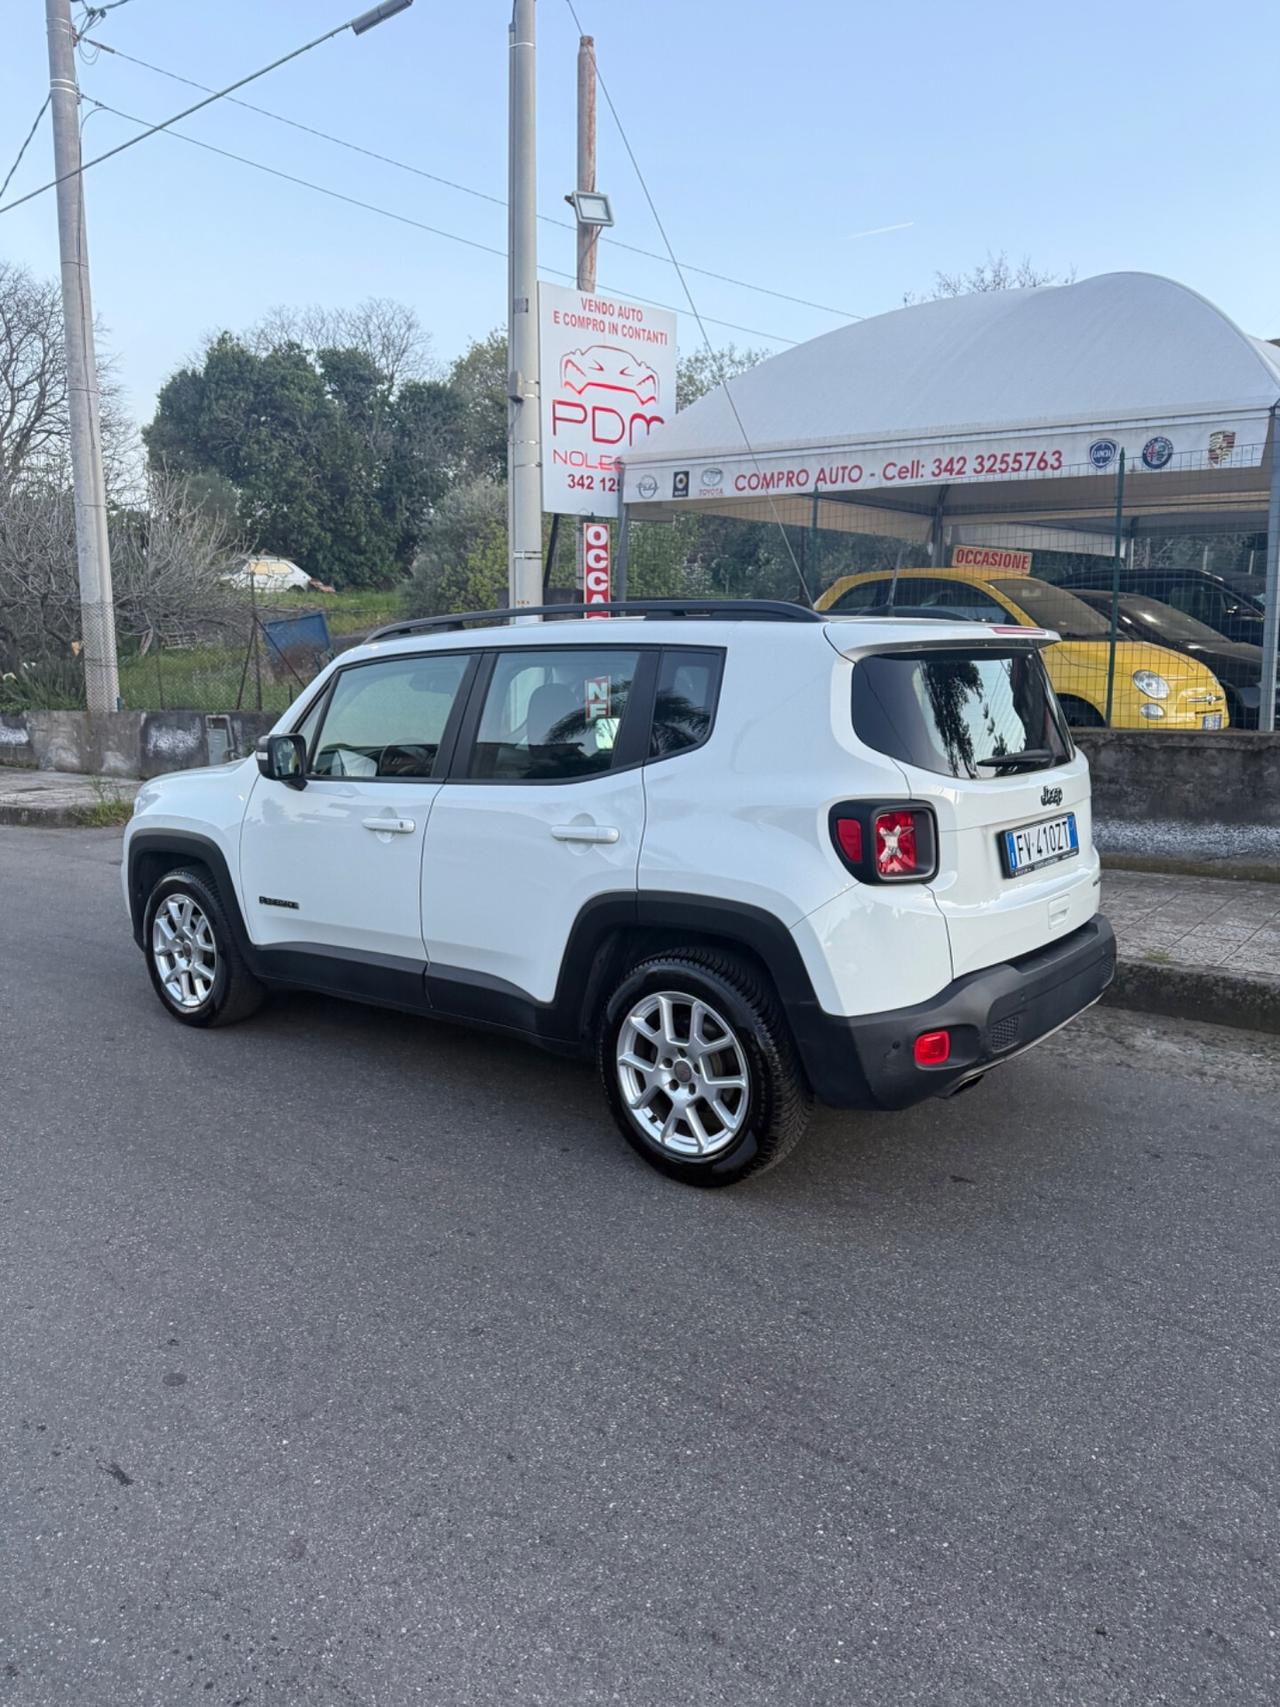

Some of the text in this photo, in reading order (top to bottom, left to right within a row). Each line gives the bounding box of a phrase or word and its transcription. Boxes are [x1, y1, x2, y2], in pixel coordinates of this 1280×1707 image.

[581, 297, 643, 322] VENDO AUTO
[553, 310, 668, 345] E COMPRO IN CONTANTI
[567, 474, 620, 492] 342 12
[734, 469, 809, 491] COMPRO
[816, 464, 863, 485] AUTO
[882, 459, 925, 481] Cell:
[931, 456, 967, 477] 342
[973, 450, 1063, 474] 3255763
[956, 549, 1029, 570] OCCASIONE
